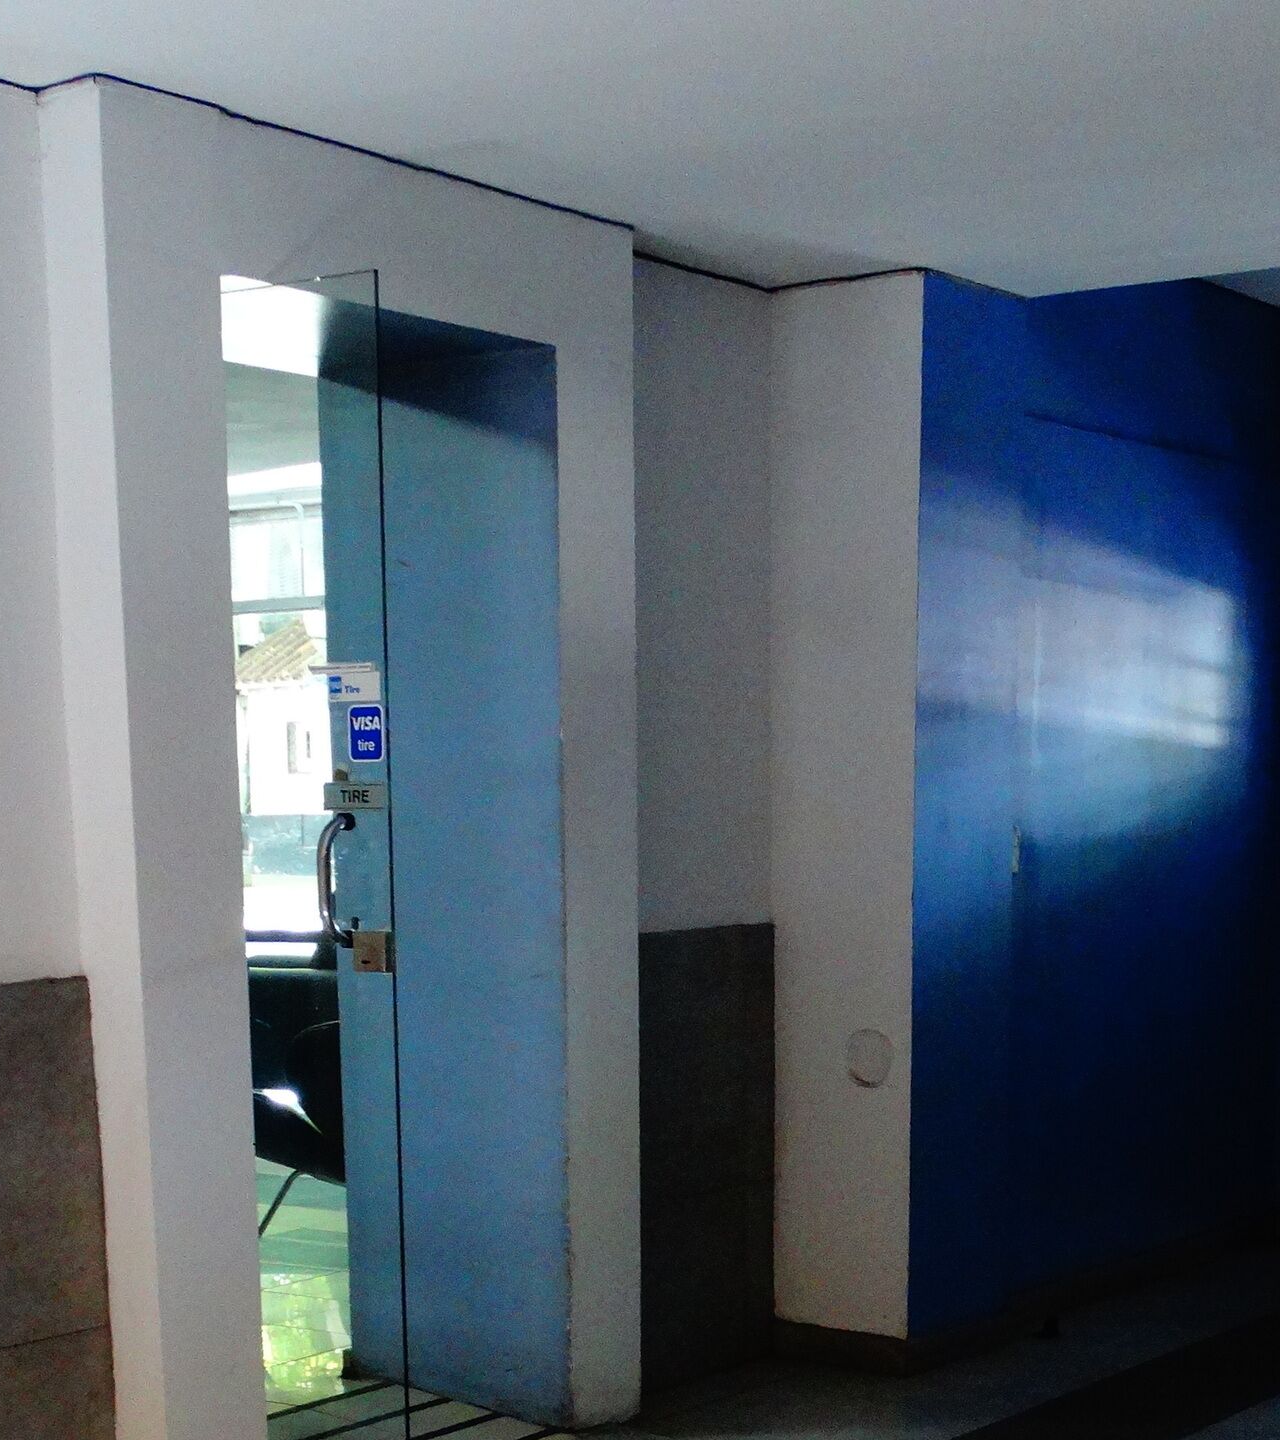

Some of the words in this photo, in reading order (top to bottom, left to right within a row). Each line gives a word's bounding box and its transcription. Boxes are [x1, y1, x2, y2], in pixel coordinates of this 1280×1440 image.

[351, 716, 381, 731] VISA
[357, 738, 376, 752] tire
[340, 789, 370, 803] TIRE
